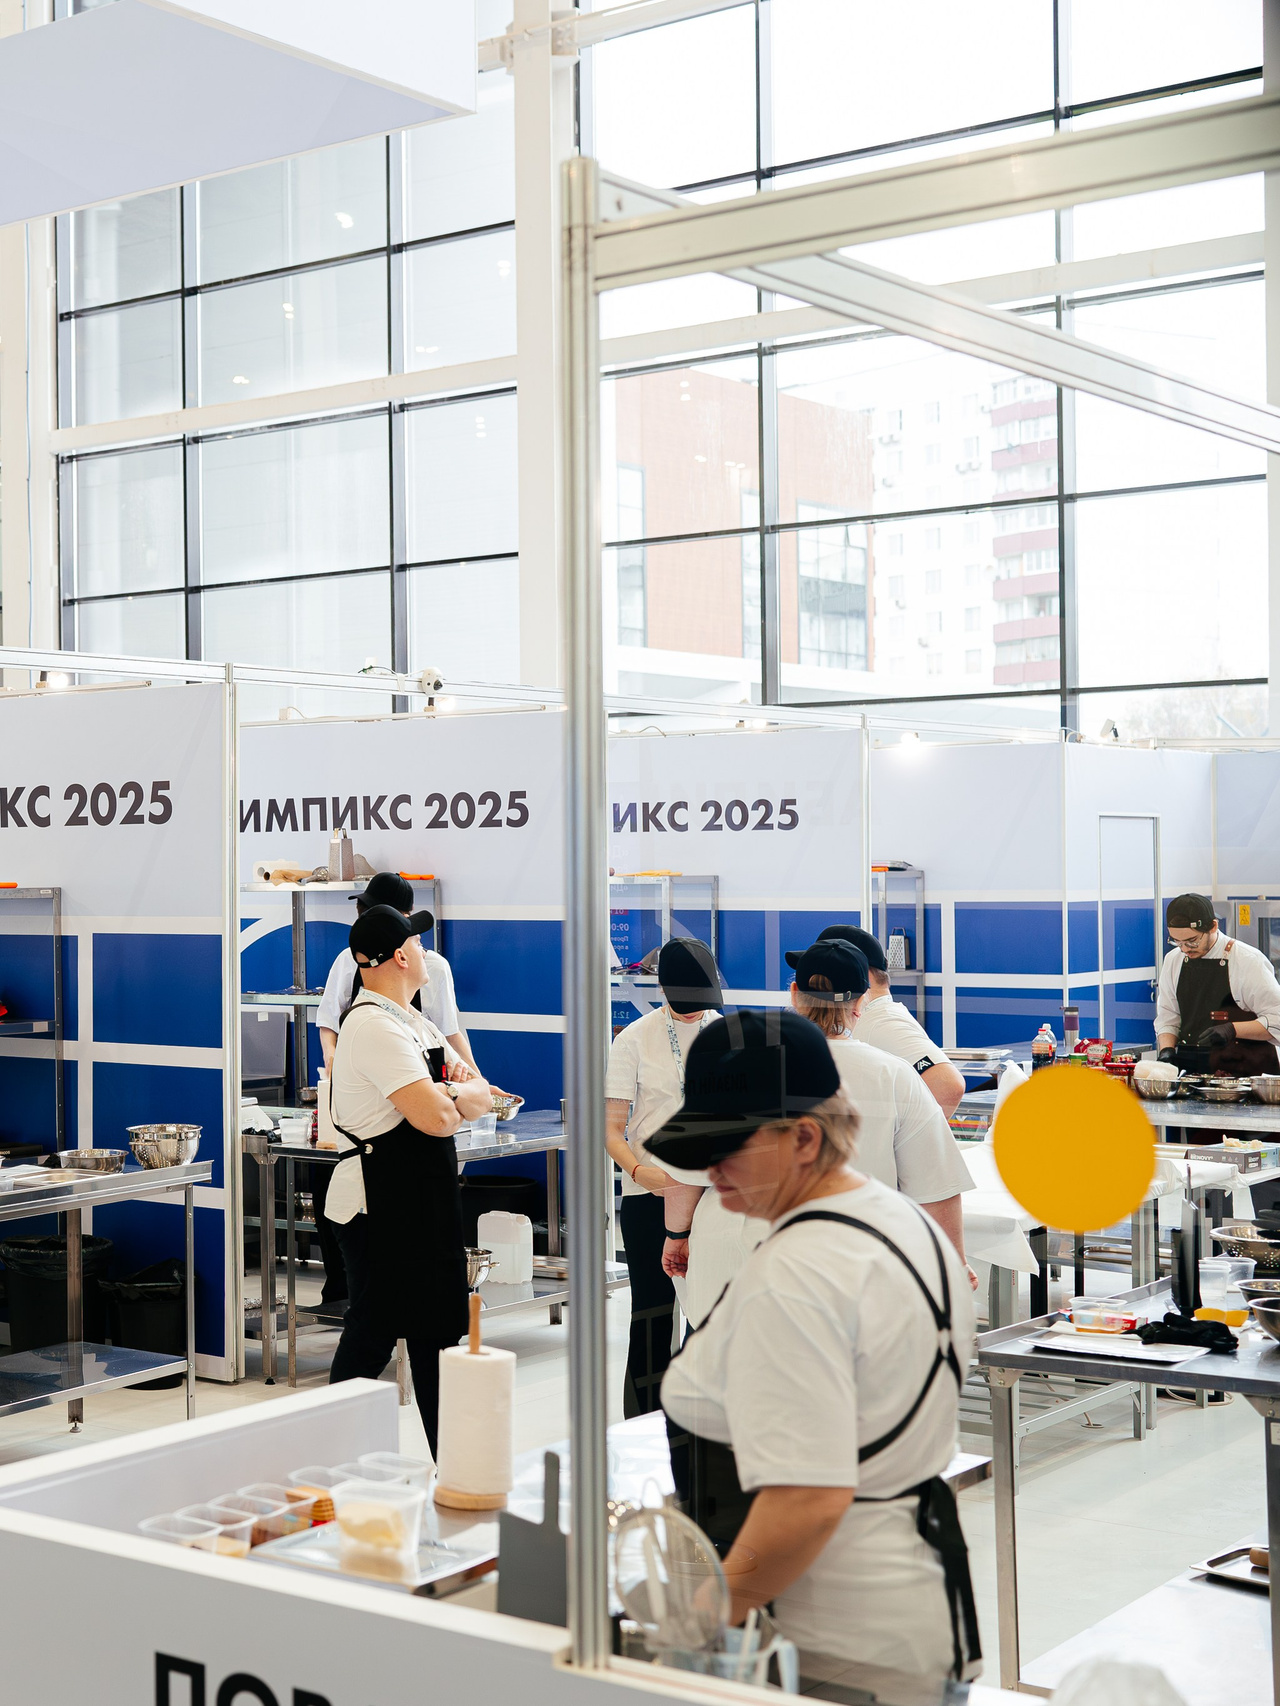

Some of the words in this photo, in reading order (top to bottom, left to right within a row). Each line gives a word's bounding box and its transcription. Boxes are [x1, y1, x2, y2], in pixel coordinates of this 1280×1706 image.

[63, 780, 173, 827] 2025
[424, 790, 530, 830] 2025
[700, 798, 800, 832] 2025
